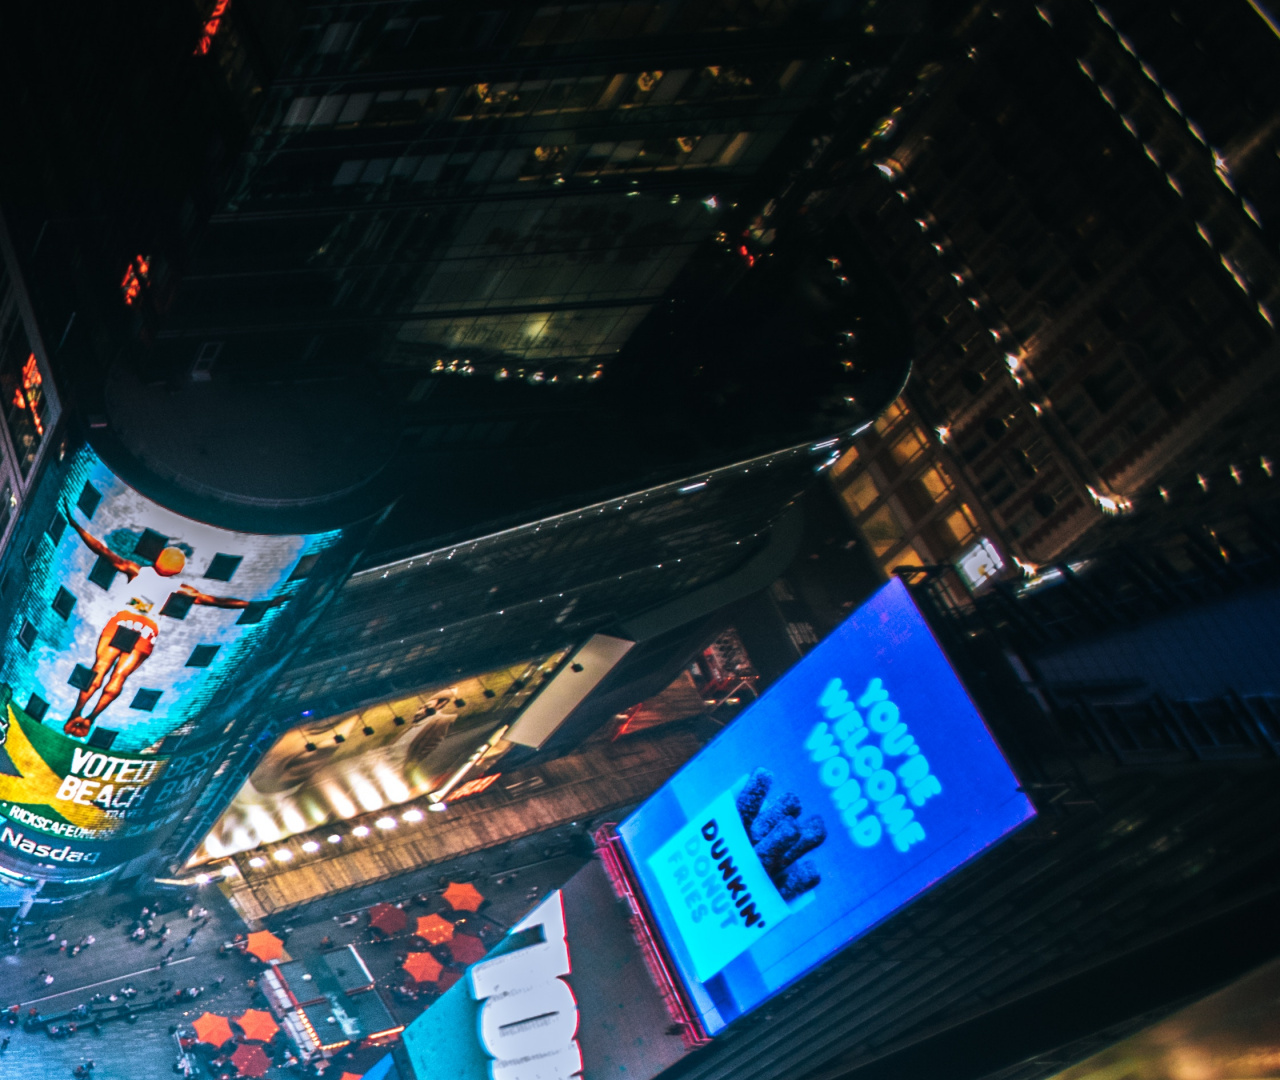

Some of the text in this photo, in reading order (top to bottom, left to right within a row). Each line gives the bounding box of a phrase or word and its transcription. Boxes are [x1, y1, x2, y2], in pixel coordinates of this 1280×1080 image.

[70, 748, 157, 783] VOTED
[804, 722, 882, 848] WORLD
[818, 677, 926, 852] WELCOME
[859, 677, 942, 807] YOU'RE
[56, 775, 150, 809] BEACH
[0, 827, 101, 863] Nasdaq
[668, 851, 709, 924] FRIES
[685, 834, 740, 929] DONUT
[701, 818, 766, 928] DUNKIN'
